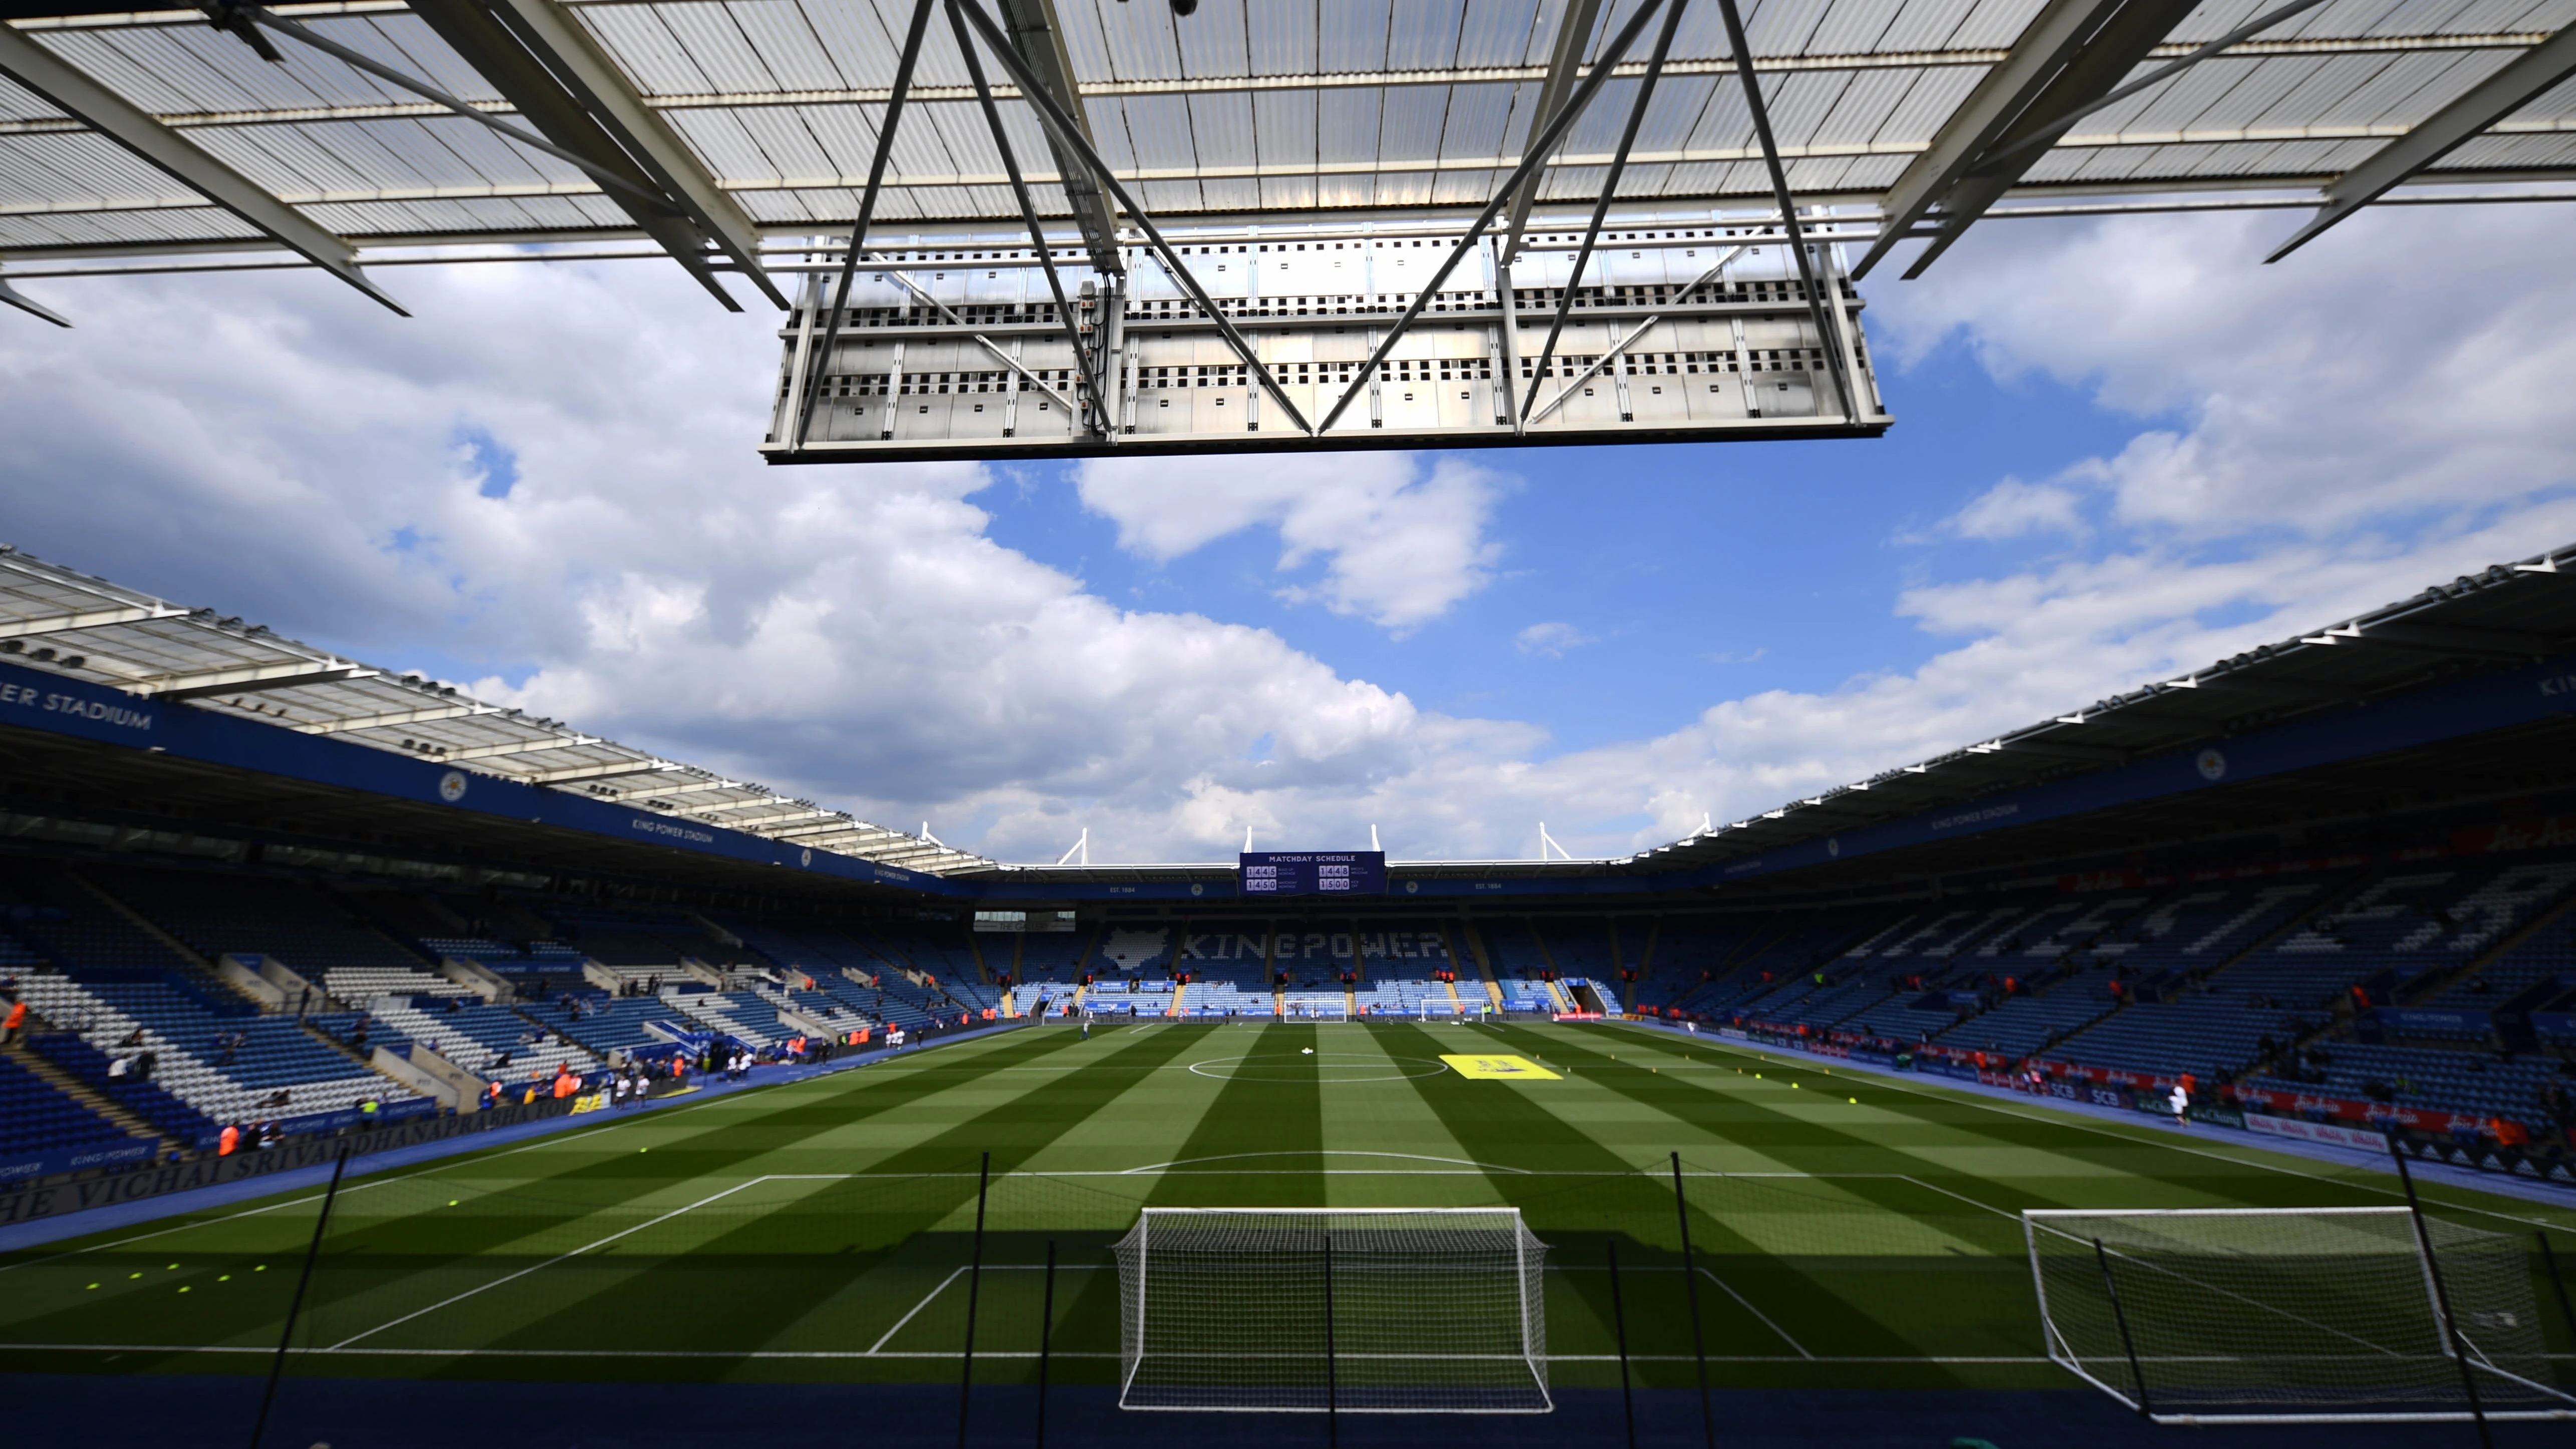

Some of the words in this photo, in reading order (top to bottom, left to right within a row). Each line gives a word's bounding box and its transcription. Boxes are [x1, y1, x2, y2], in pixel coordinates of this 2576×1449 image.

[0, 681, 39, 707] ER
[42, 693, 153, 730] STADIUM
[1931, 817, 1952, 830] KING
[1952, 811, 1981, 825] POWER
[1982, 803, 2019, 820] STADIUM
[631, 818, 655, 832] KING
[655, 823, 684, 837] POWER
[683, 829, 714, 843] STADIUM
[1247, 867, 1276, 877] 1445
[1320, 866, 1349, 877] 1448
[1247, 880, 1276, 890] 1450
[1320, 880, 1349, 889] 1500
[2050, 1083, 2076, 1098] SCB
[2091, 1089, 2120, 1106] SCB
[2205, 1107, 2242, 1127] Chang
[70, 1153, 104, 1167] KING
[104, 1145, 149, 1160] POWER
[77, 1160, 224, 1208] VICHAI
